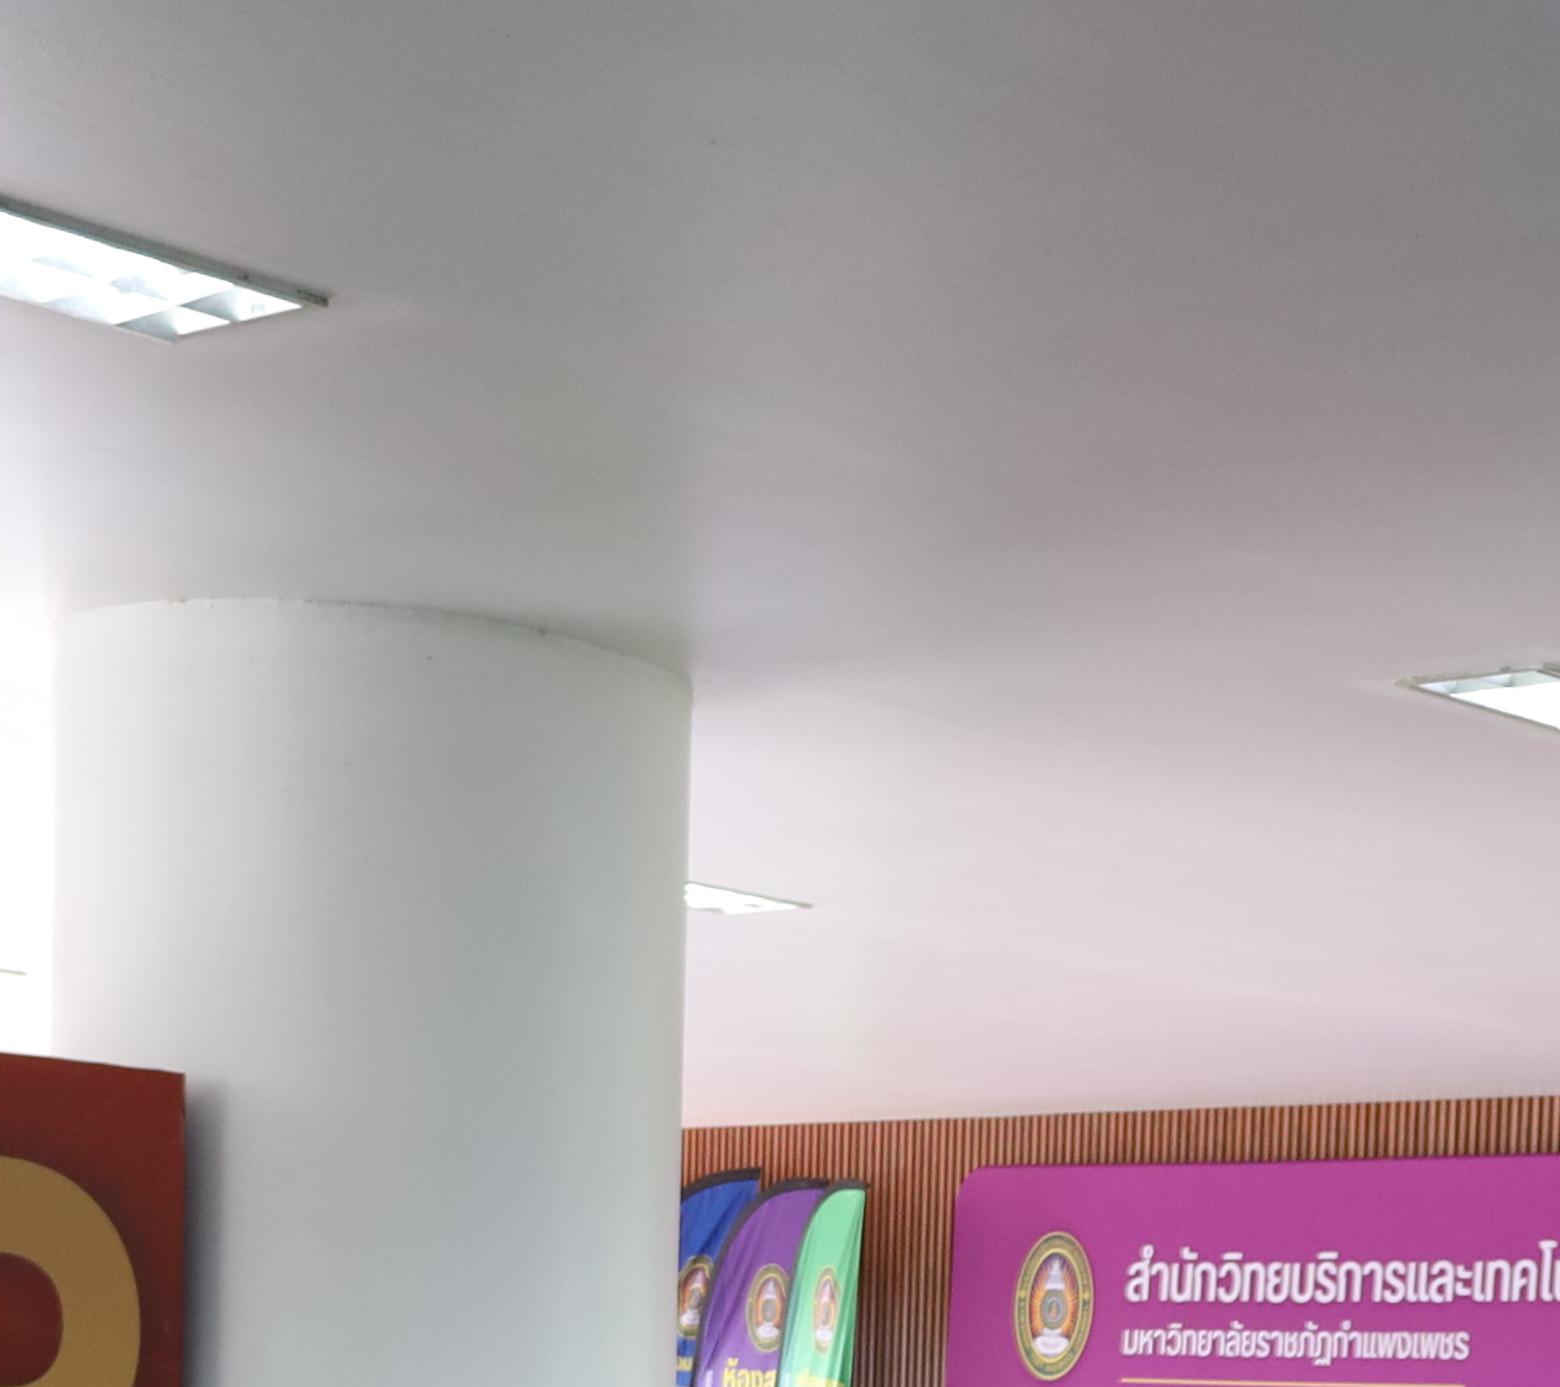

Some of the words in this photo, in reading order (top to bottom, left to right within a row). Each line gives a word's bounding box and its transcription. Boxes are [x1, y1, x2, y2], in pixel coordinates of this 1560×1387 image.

[1121, 1320, 1472, 1367] มหาวิทยาลัยราชภัฏกำแพงเพชร
